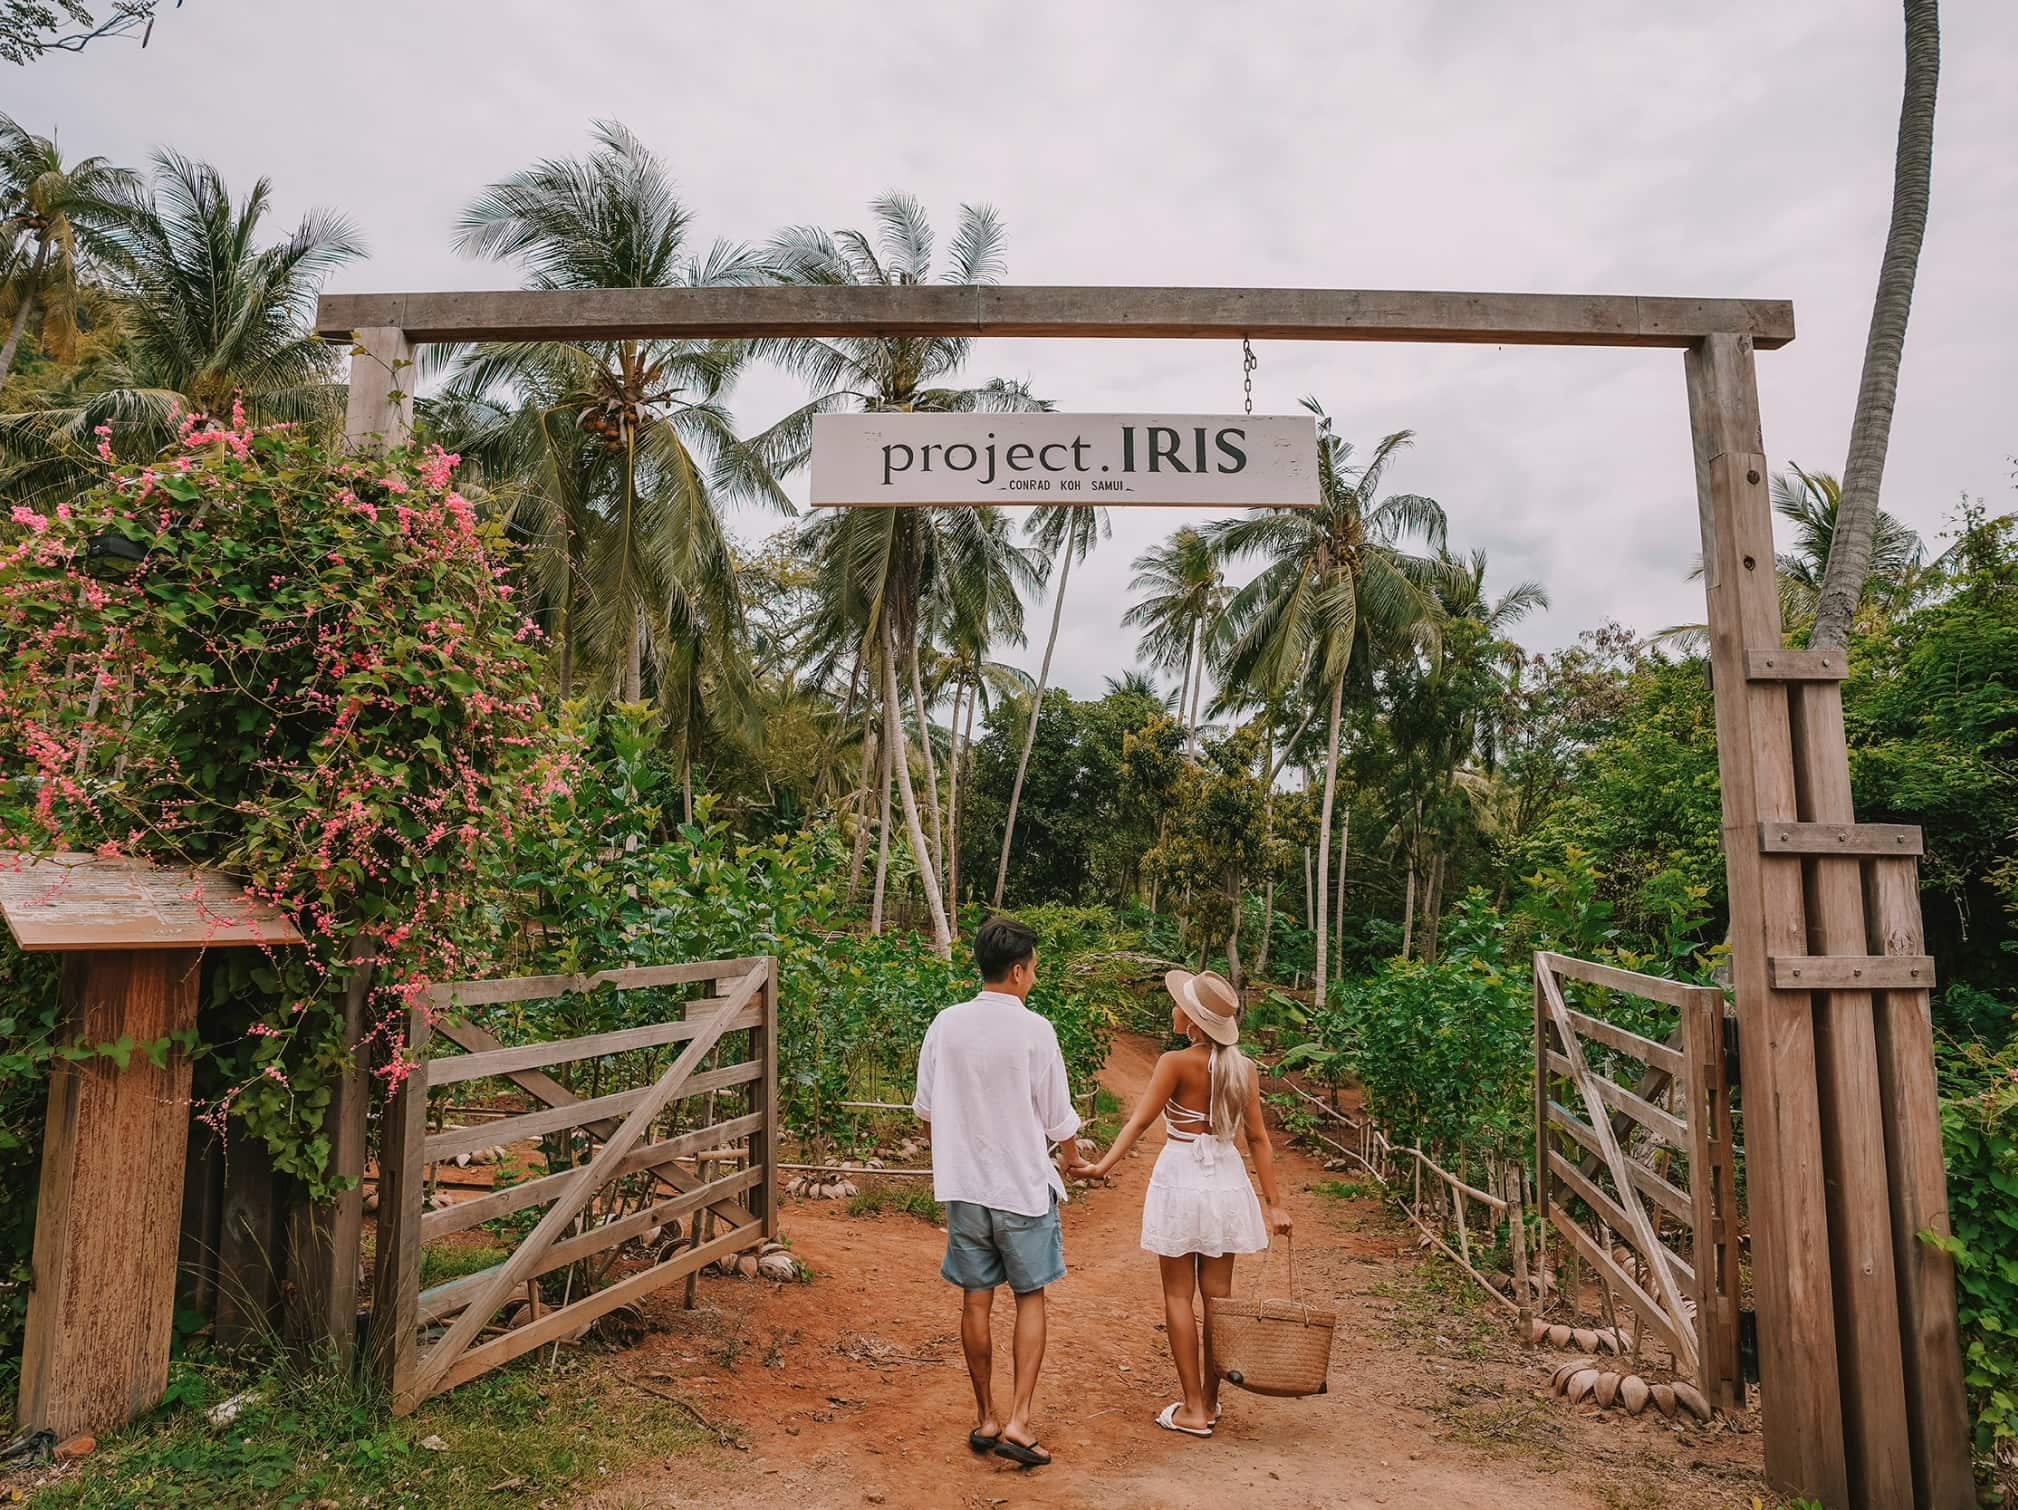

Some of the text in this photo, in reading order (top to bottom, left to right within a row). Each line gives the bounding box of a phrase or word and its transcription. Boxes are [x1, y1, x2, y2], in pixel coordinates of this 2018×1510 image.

[1009, 479, 1124, 491] CONRAD KOH SAMUI
